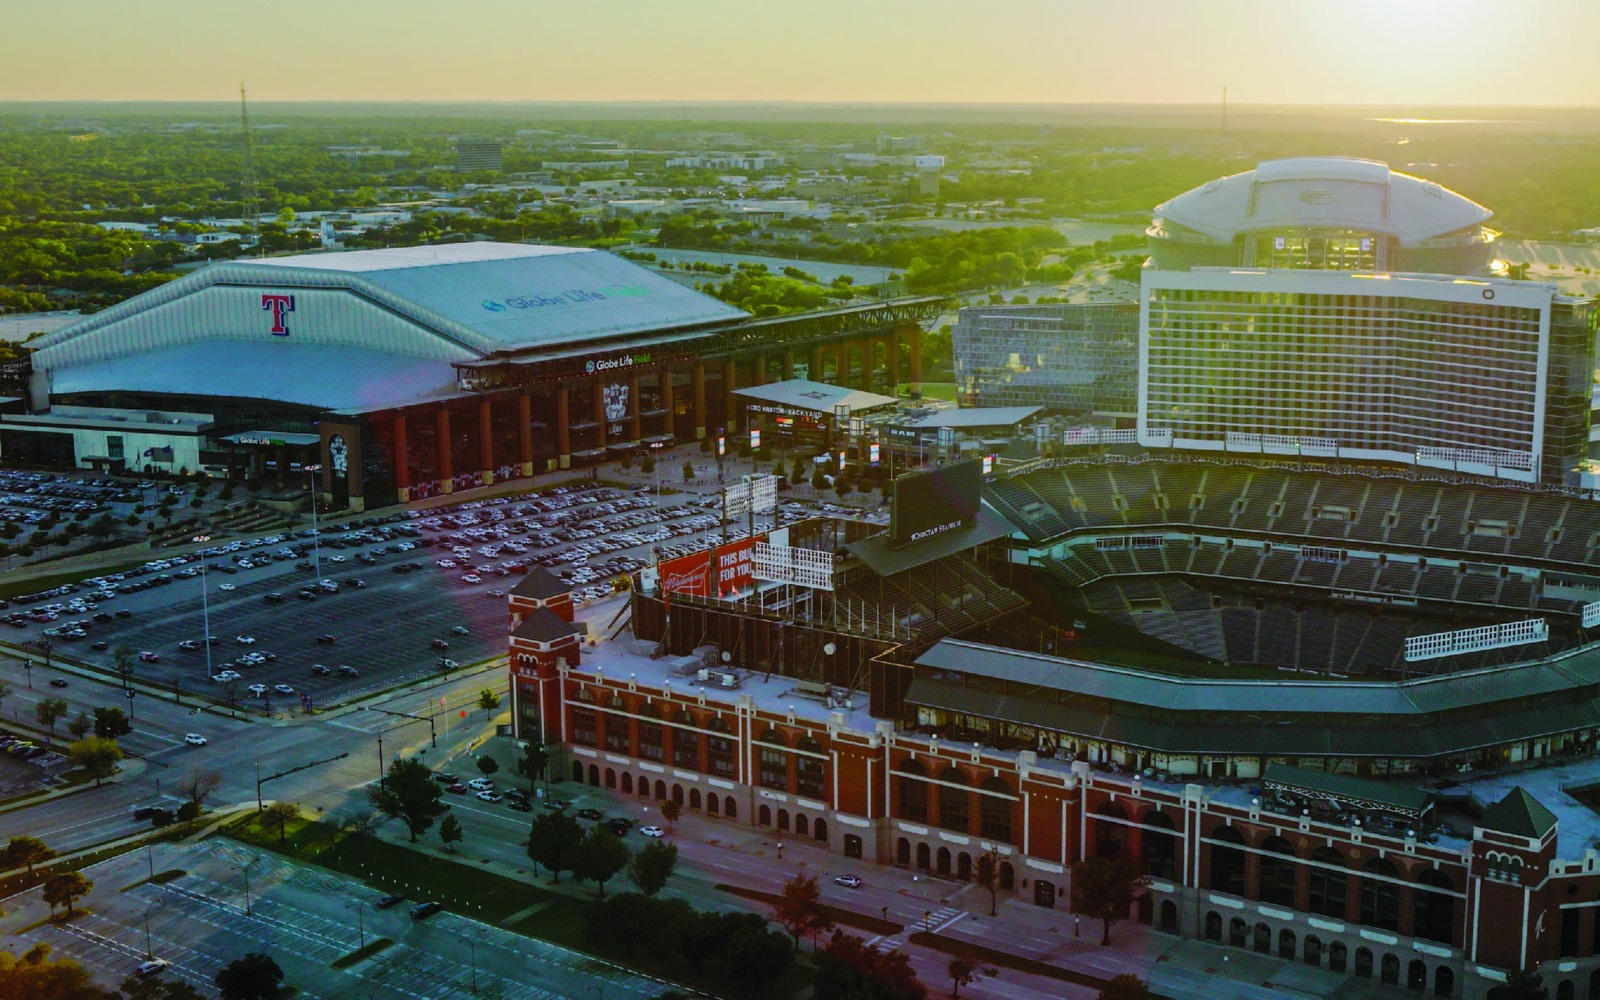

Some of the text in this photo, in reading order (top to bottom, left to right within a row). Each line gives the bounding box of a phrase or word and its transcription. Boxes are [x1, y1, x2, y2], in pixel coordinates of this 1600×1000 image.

[505, 295, 567, 309] Globe
[564, 289, 606, 302] Life
[261, 294, 295, 336] T
[596, 359, 619, 370] Globe
[619, 354, 634, 367] Life
[787, 408, 823, 419] BACKYARD
[240, 436, 258, 444] Globe
[891, 429, 915, 437] RAM
[911, 519, 962, 541] CHOCTAW STADIUM
[720, 547, 752, 568] THIS BU
[664, 572, 705, 591] Budweiser
[720, 562, 752, 583] FOR YOU
